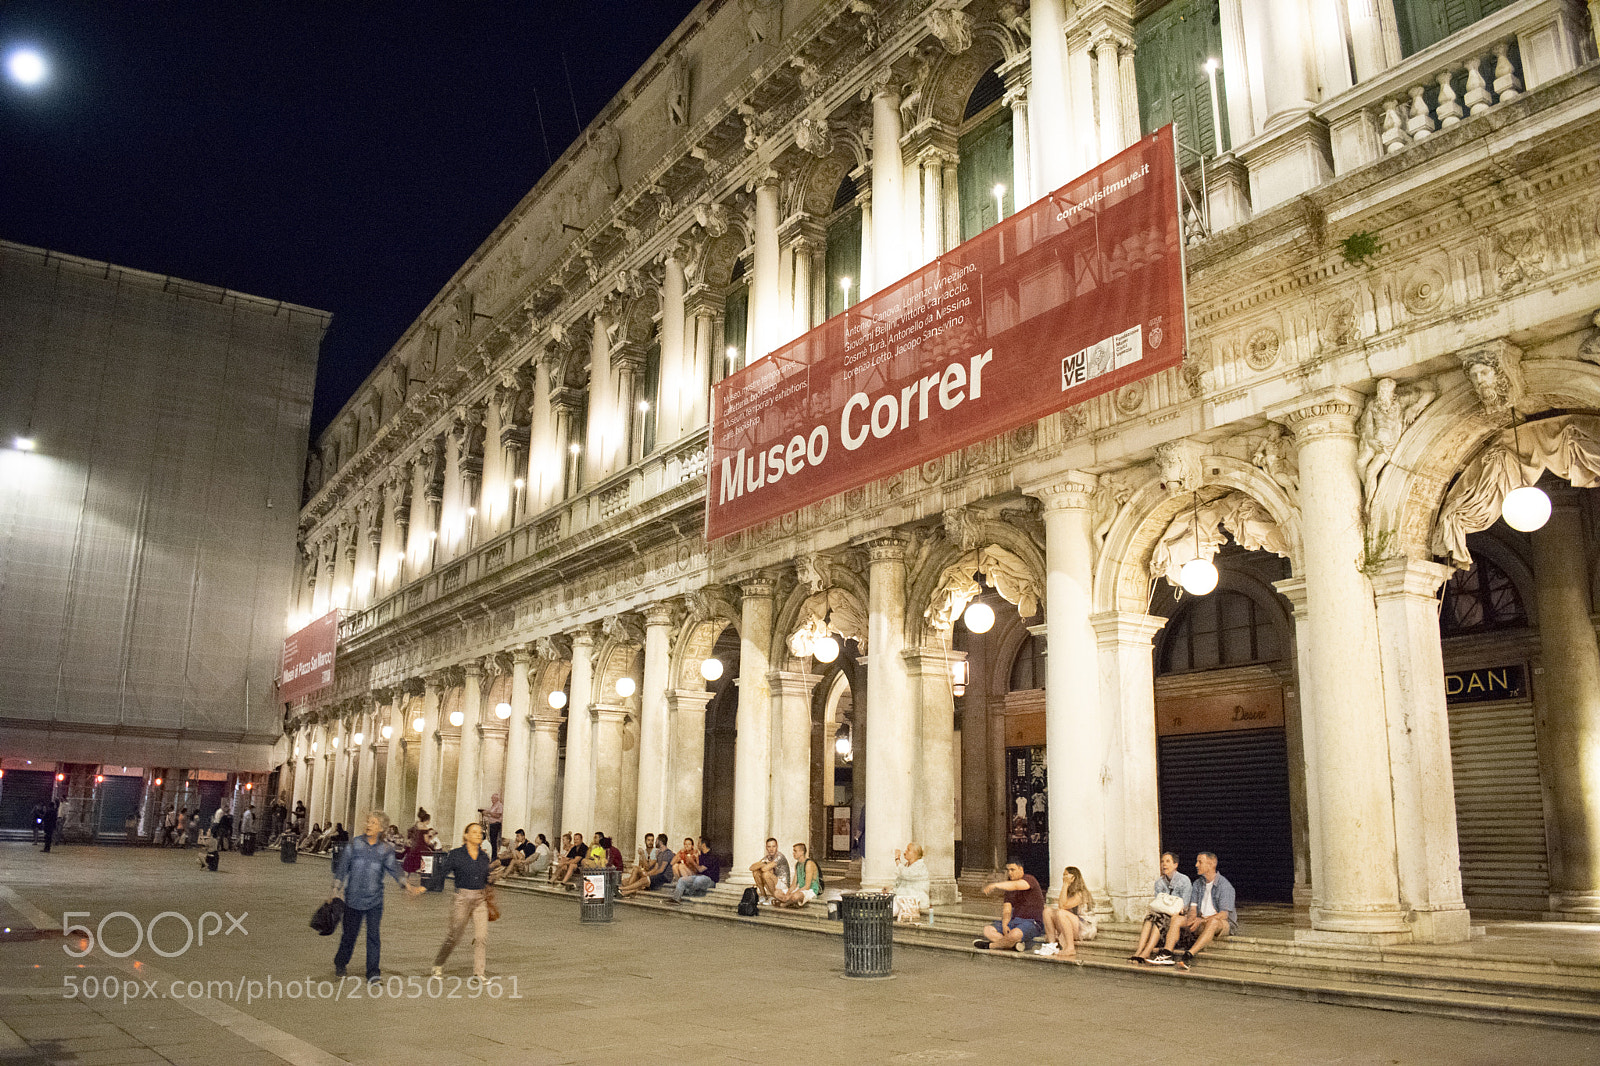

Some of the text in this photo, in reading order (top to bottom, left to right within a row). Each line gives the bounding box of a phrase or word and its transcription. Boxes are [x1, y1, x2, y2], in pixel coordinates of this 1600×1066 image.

[1056, 163, 1150, 221] correr.visitmuve.it
[844, 330, 873, 352] Giovanni
[901, 305, 926, 324] Vittore
[845, 319, 872, 338] Antonio
[872, 304, 901, 323] Canova,
[902, 286, 932, 308] Lorenzo
[888, 320, 924, 345] Antonello
[924, 314, 933, 326] da
[843, 315, 964, 380] Lorenzo Lotto, Jacopo Sansovino
[1063, 352, 1085, 374] MU
[1064, 367, 1085, 386] VE
[719, 349, 993, 506] Museo Correr
